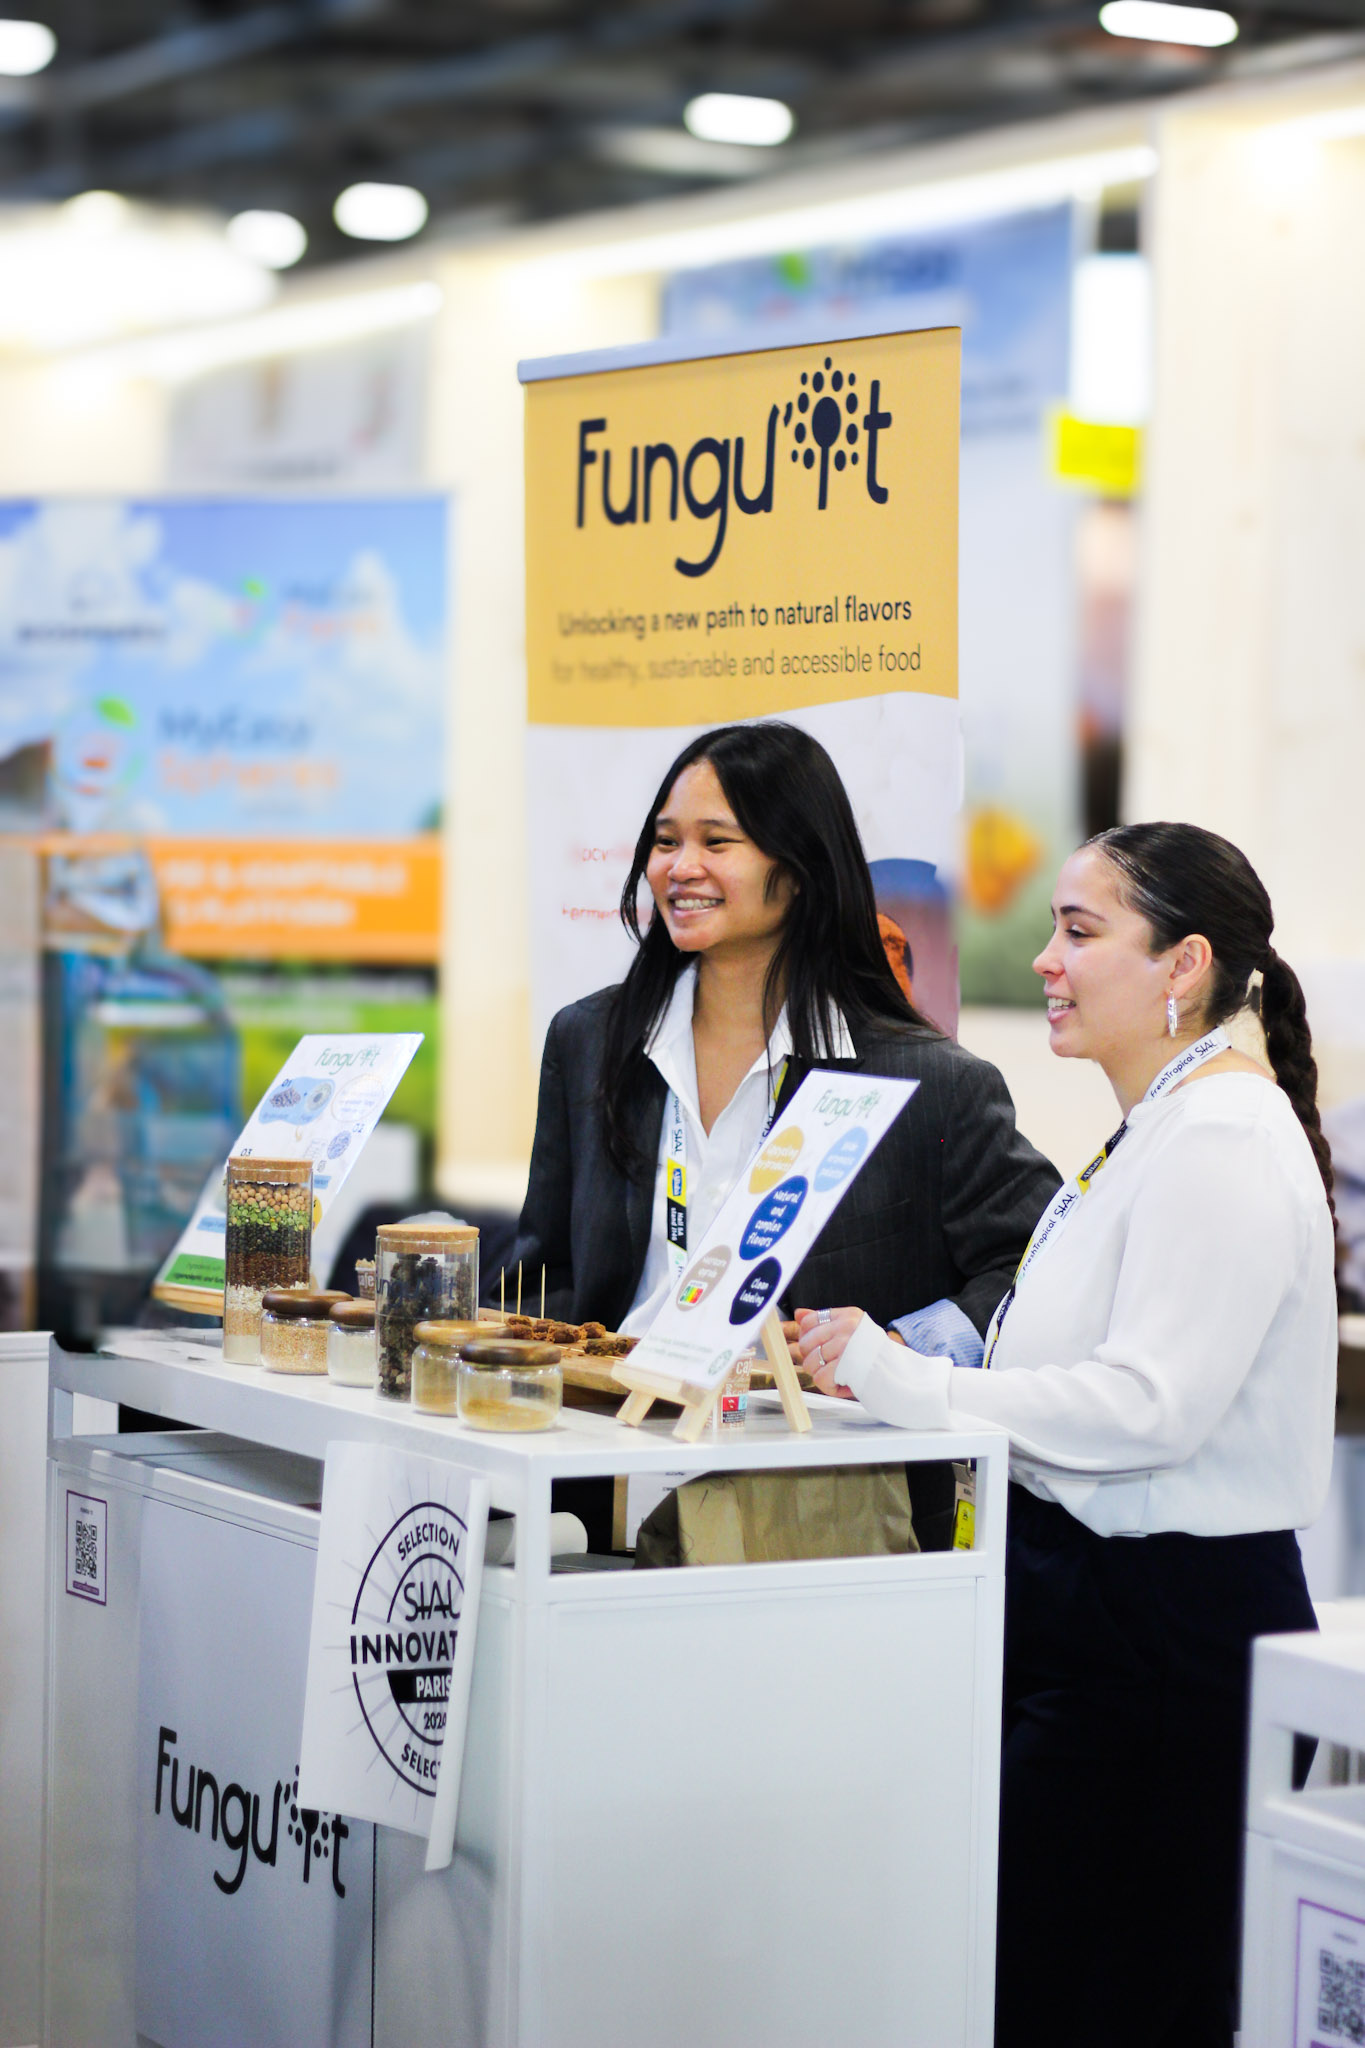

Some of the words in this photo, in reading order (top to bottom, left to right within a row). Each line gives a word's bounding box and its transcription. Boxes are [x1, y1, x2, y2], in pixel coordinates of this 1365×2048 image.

[651, 613, 659, 632] a
[665, 611, 700, 631] new
[706, 600, 745, 636] path
[751, 603, 768, 626] to
[775, 595, 839, 625] natural
[845, 594, 912, 622] flavors
[743, 649, 775, 676] and
[781, 644, 872, 675] accessible
[879, 643, 921, 671] food
[1194, 1039, 1217, 1056] SIAL
[674, 1128, 683, 1156] SIAL
[773, 1190, 802, 1203] Natural
[770, 1205, 787, 1217] and
[755, 1219, 782, 1233] complex
[1022, 1218, 1057, 1273] FreshTropical
[1054, 1193, 1078, 1218] SIAL
[746, 1232, 773, 1247] flavors
[750, 1277, 769, 1290] Clean
[398, 1522, 460, 1561] SELECTION
[403, 1579, 461, 1622] SIAL
[416, 1673, 452, 1699] PARIS
